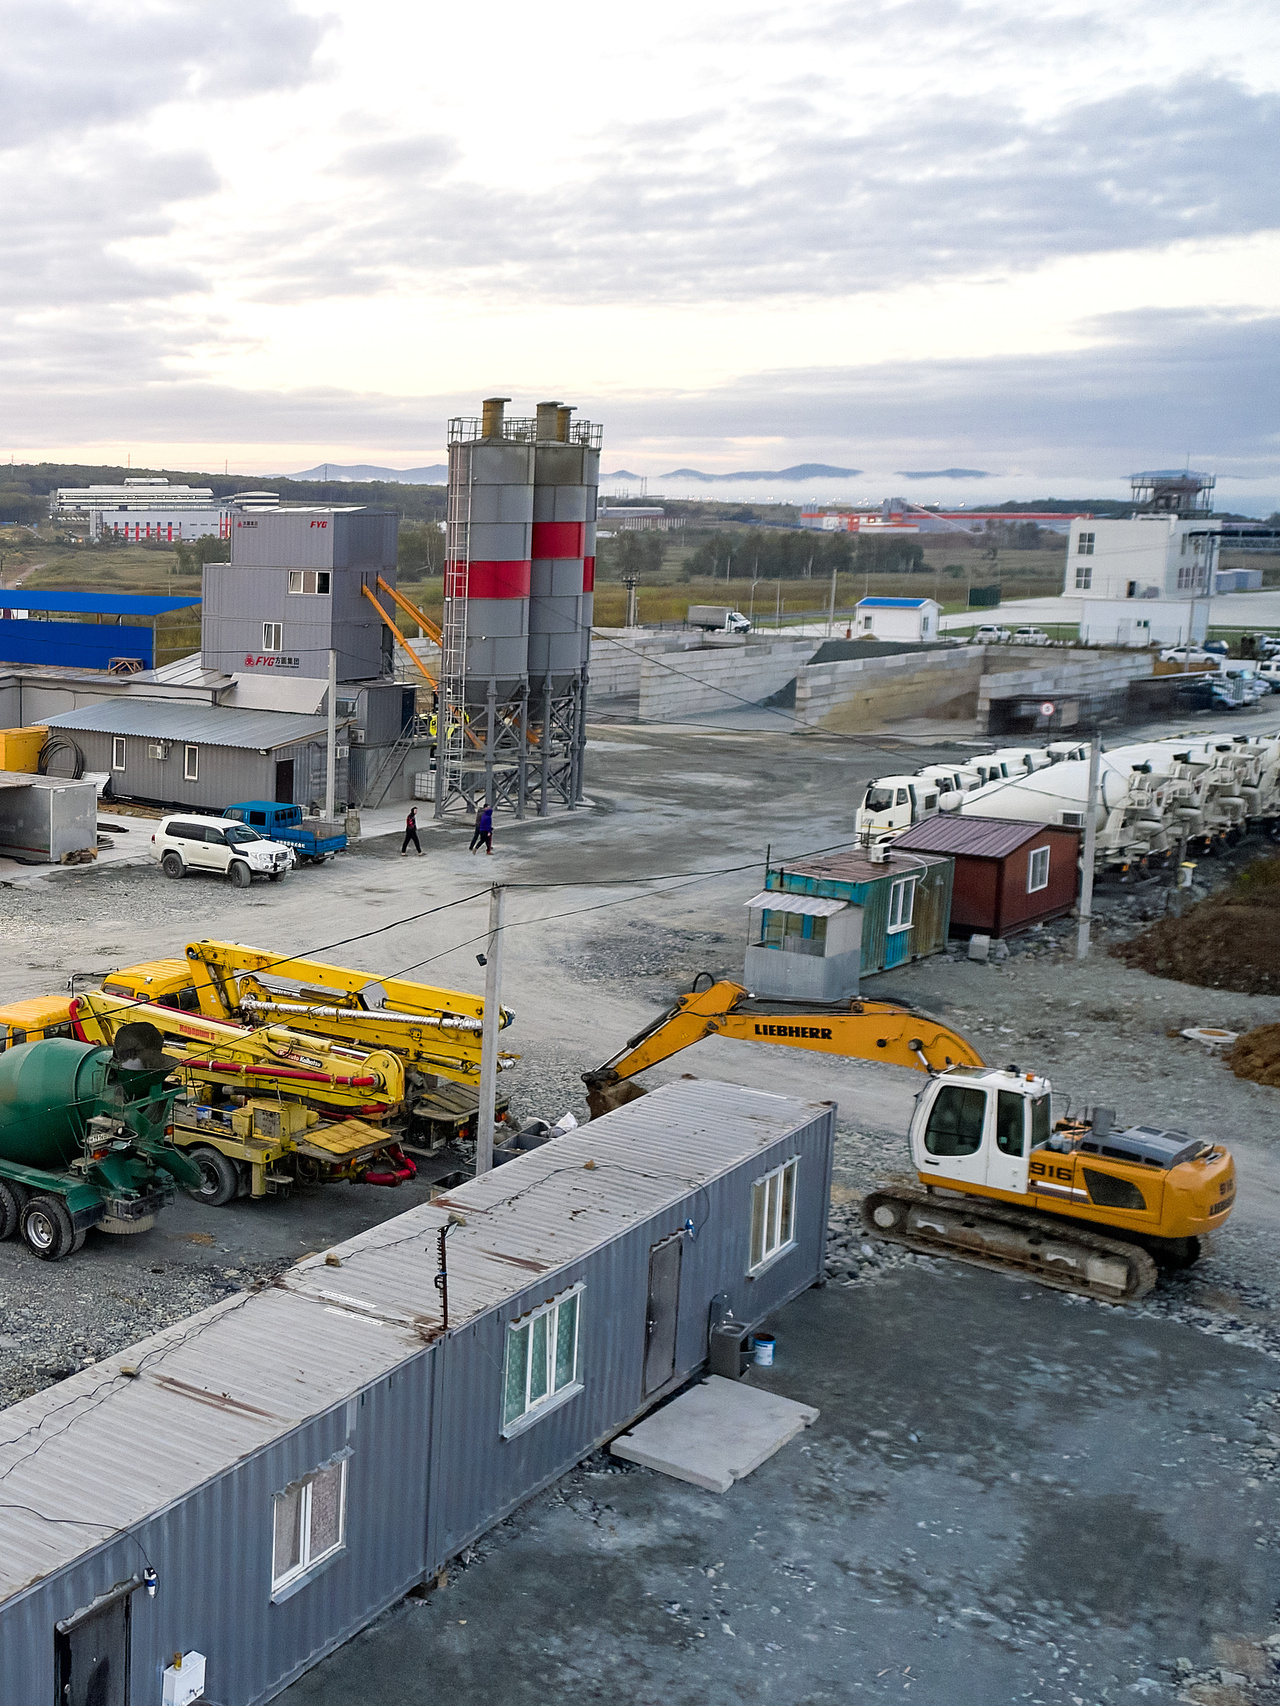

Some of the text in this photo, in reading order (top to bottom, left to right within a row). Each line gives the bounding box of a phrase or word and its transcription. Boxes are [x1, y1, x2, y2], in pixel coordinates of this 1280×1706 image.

[255, 656, 275, 667] FYG
[754, 1023, 833, 1040] LIEBHERR
[1030, 1161, 1073, 1181] 916
